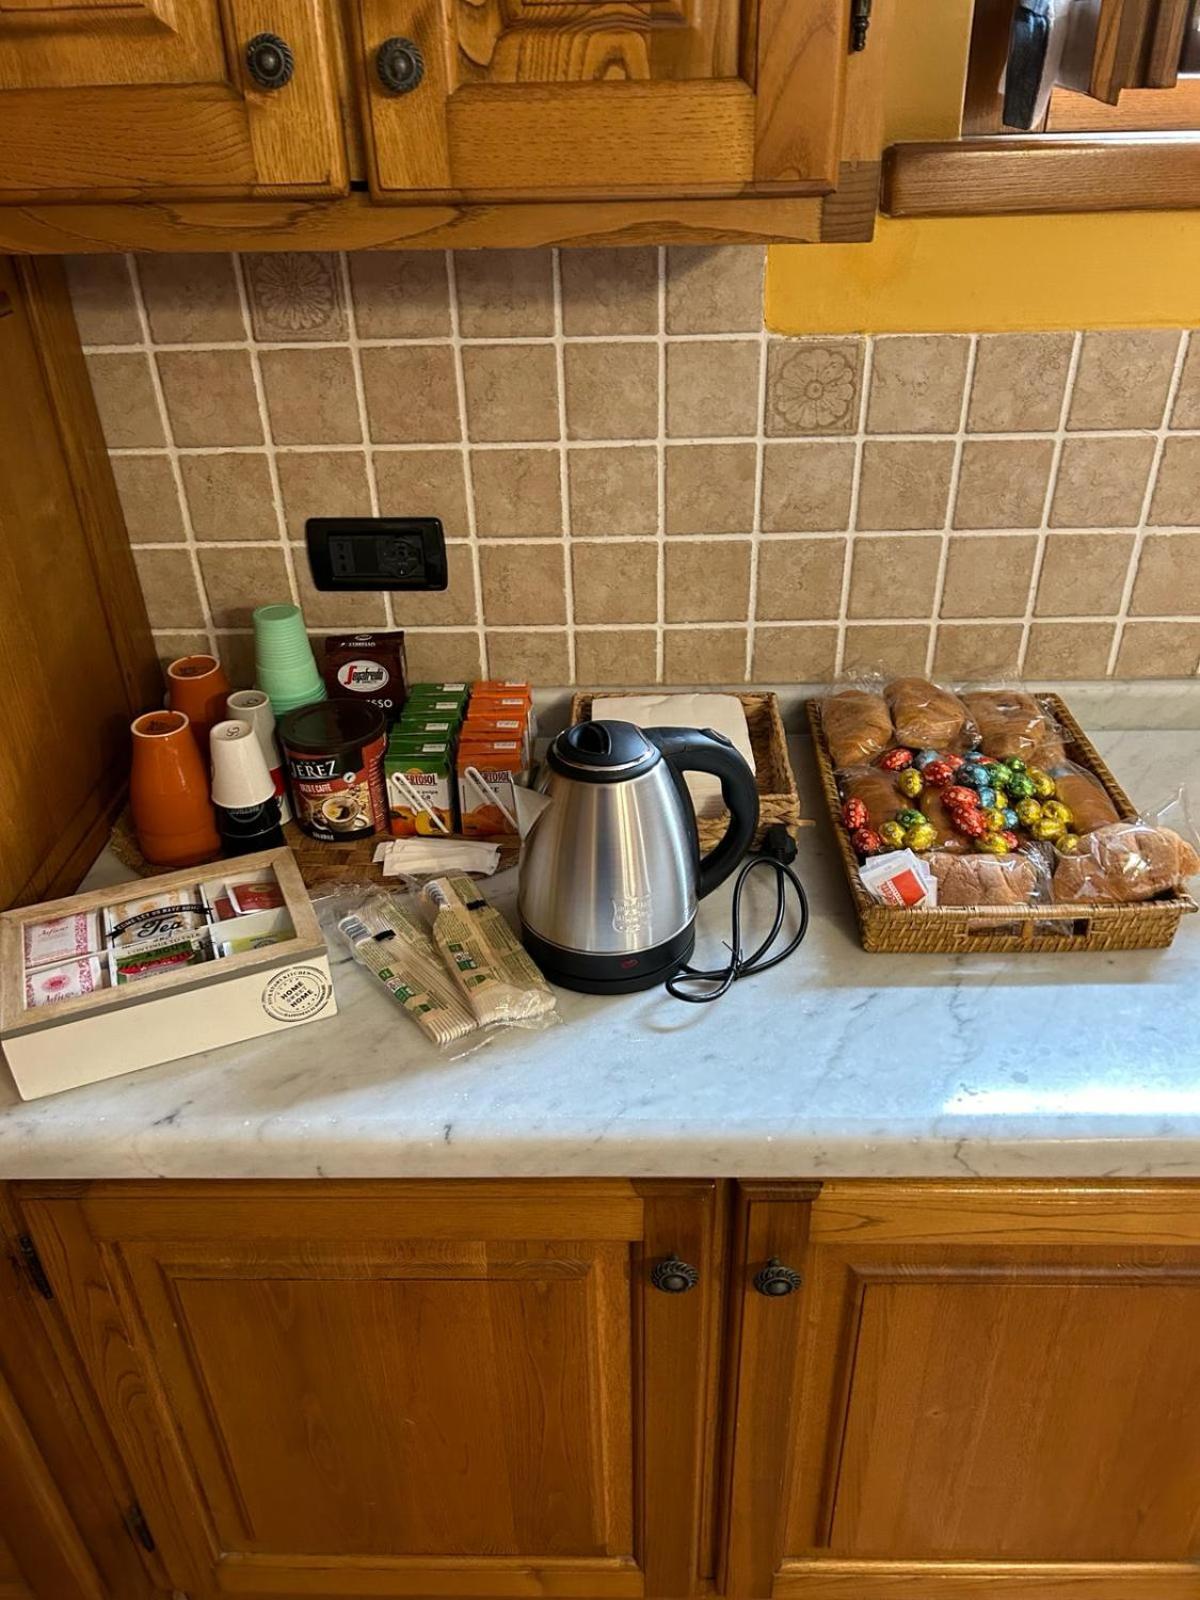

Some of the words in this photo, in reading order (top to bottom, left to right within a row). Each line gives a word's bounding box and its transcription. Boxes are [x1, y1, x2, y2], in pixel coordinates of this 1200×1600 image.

[291, 760, 340, 779] JEREZ
[137, 913, 183, 937] Tea
[281, 981, 305, 1000] HOME
[290, 989, 314, 1008] HOME
